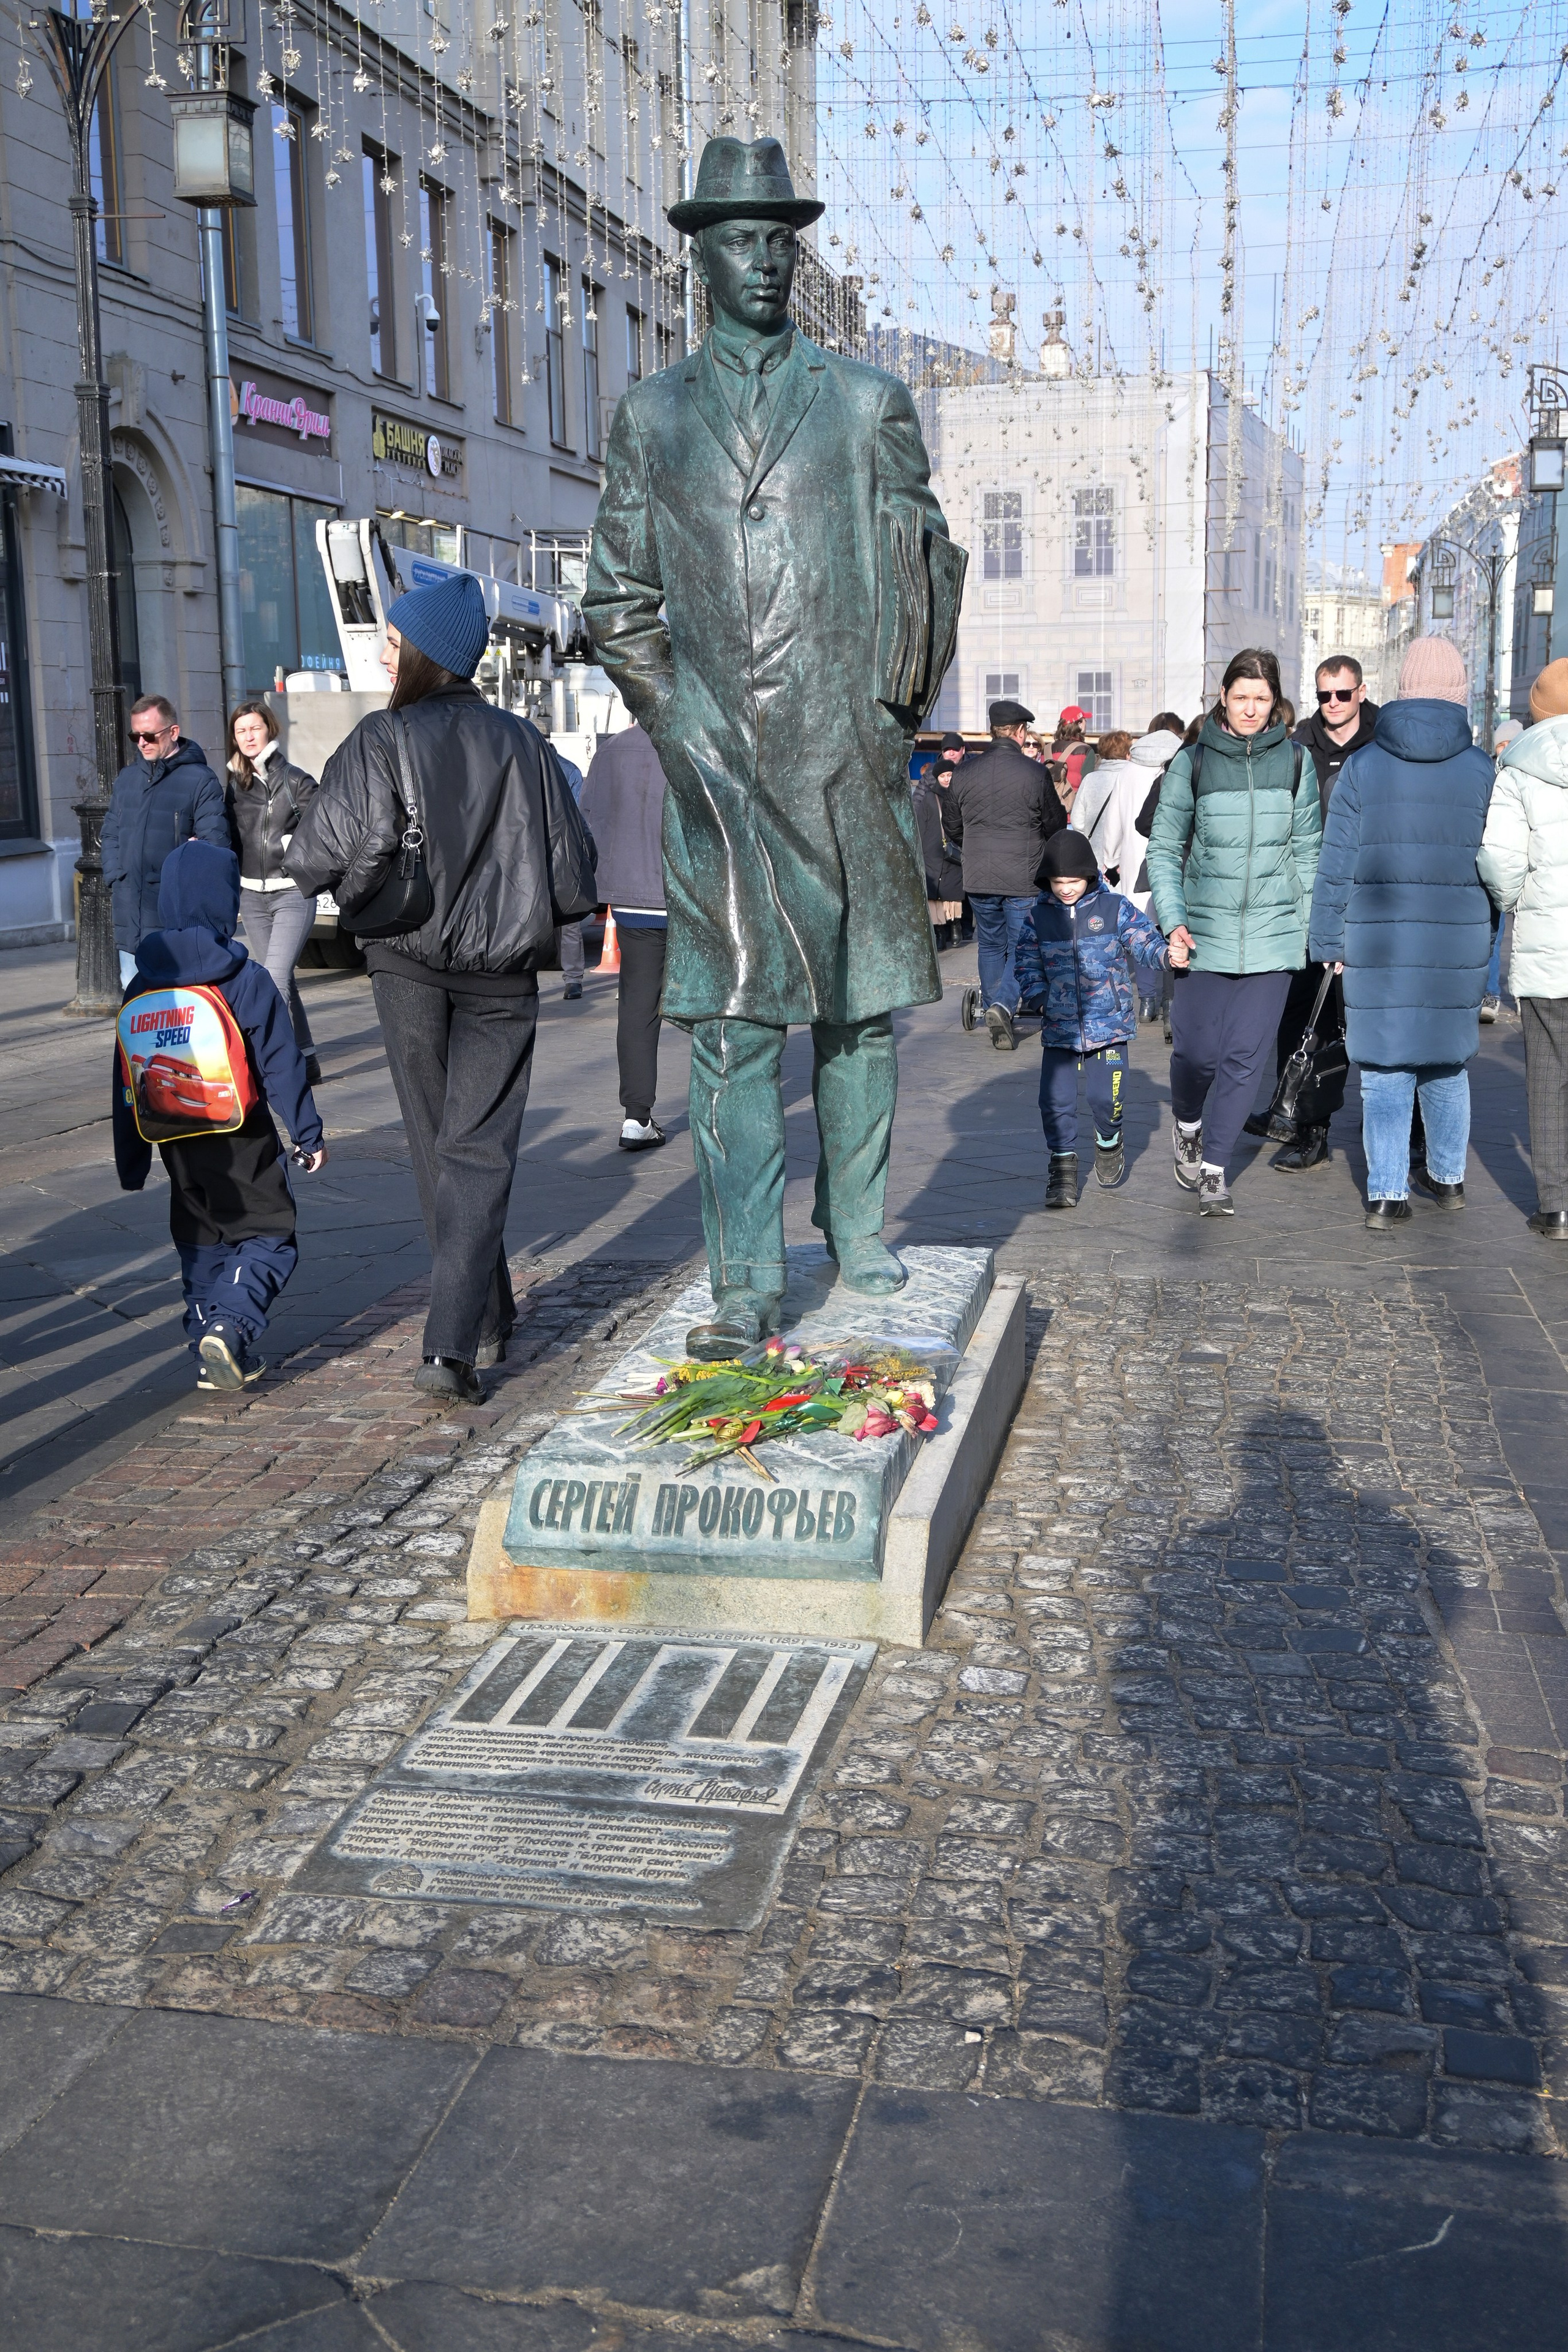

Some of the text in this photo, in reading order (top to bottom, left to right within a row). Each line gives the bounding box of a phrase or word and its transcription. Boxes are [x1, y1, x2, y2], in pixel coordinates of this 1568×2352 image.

[239, 381, 293, 428] Кранчи
[386, 421, 425, 458] БАШНЯ
[445, 461, 461, 475] PLACE
[130, 1006, 195, 1034] LIGHTNING
[155, 1026, 191, 1048] SPEED
[529, 1472, 858, 1544] СЕРГЕЙ ПРОКОФЬЕВ
[520, 1624, 614, 1633] ПРОКОФЬЕВ
[618, 1627, 676, 1637] СЕРГЕЙ
[678, 1629, 766, 1642] СЕРГЕЕВИЧ
[823, 1640, 861, 1651] 1953)
[372, 1797, 407, 1807] Один
[588, 1813, 626, 1823] мире
[493, 1816, 585, 1828] выдающийся
[349, 1825, 413, 1836] мировой
[473, 1834, 509, 1844] опер
[590, 1842, 626, 1853] трем
[356, 1815, 399, 1826] Автор
[401, 1819, 488, 1832] новаторских
[596, 1833, 655, 1845] ставших
[657, 1838, 730, 1852] классикой
[513, 1845, 570, 1858] балетов
[436, 1869, 494, 1880] ПАМЯТНИК
[581, 1863, 636, 1874] многих
